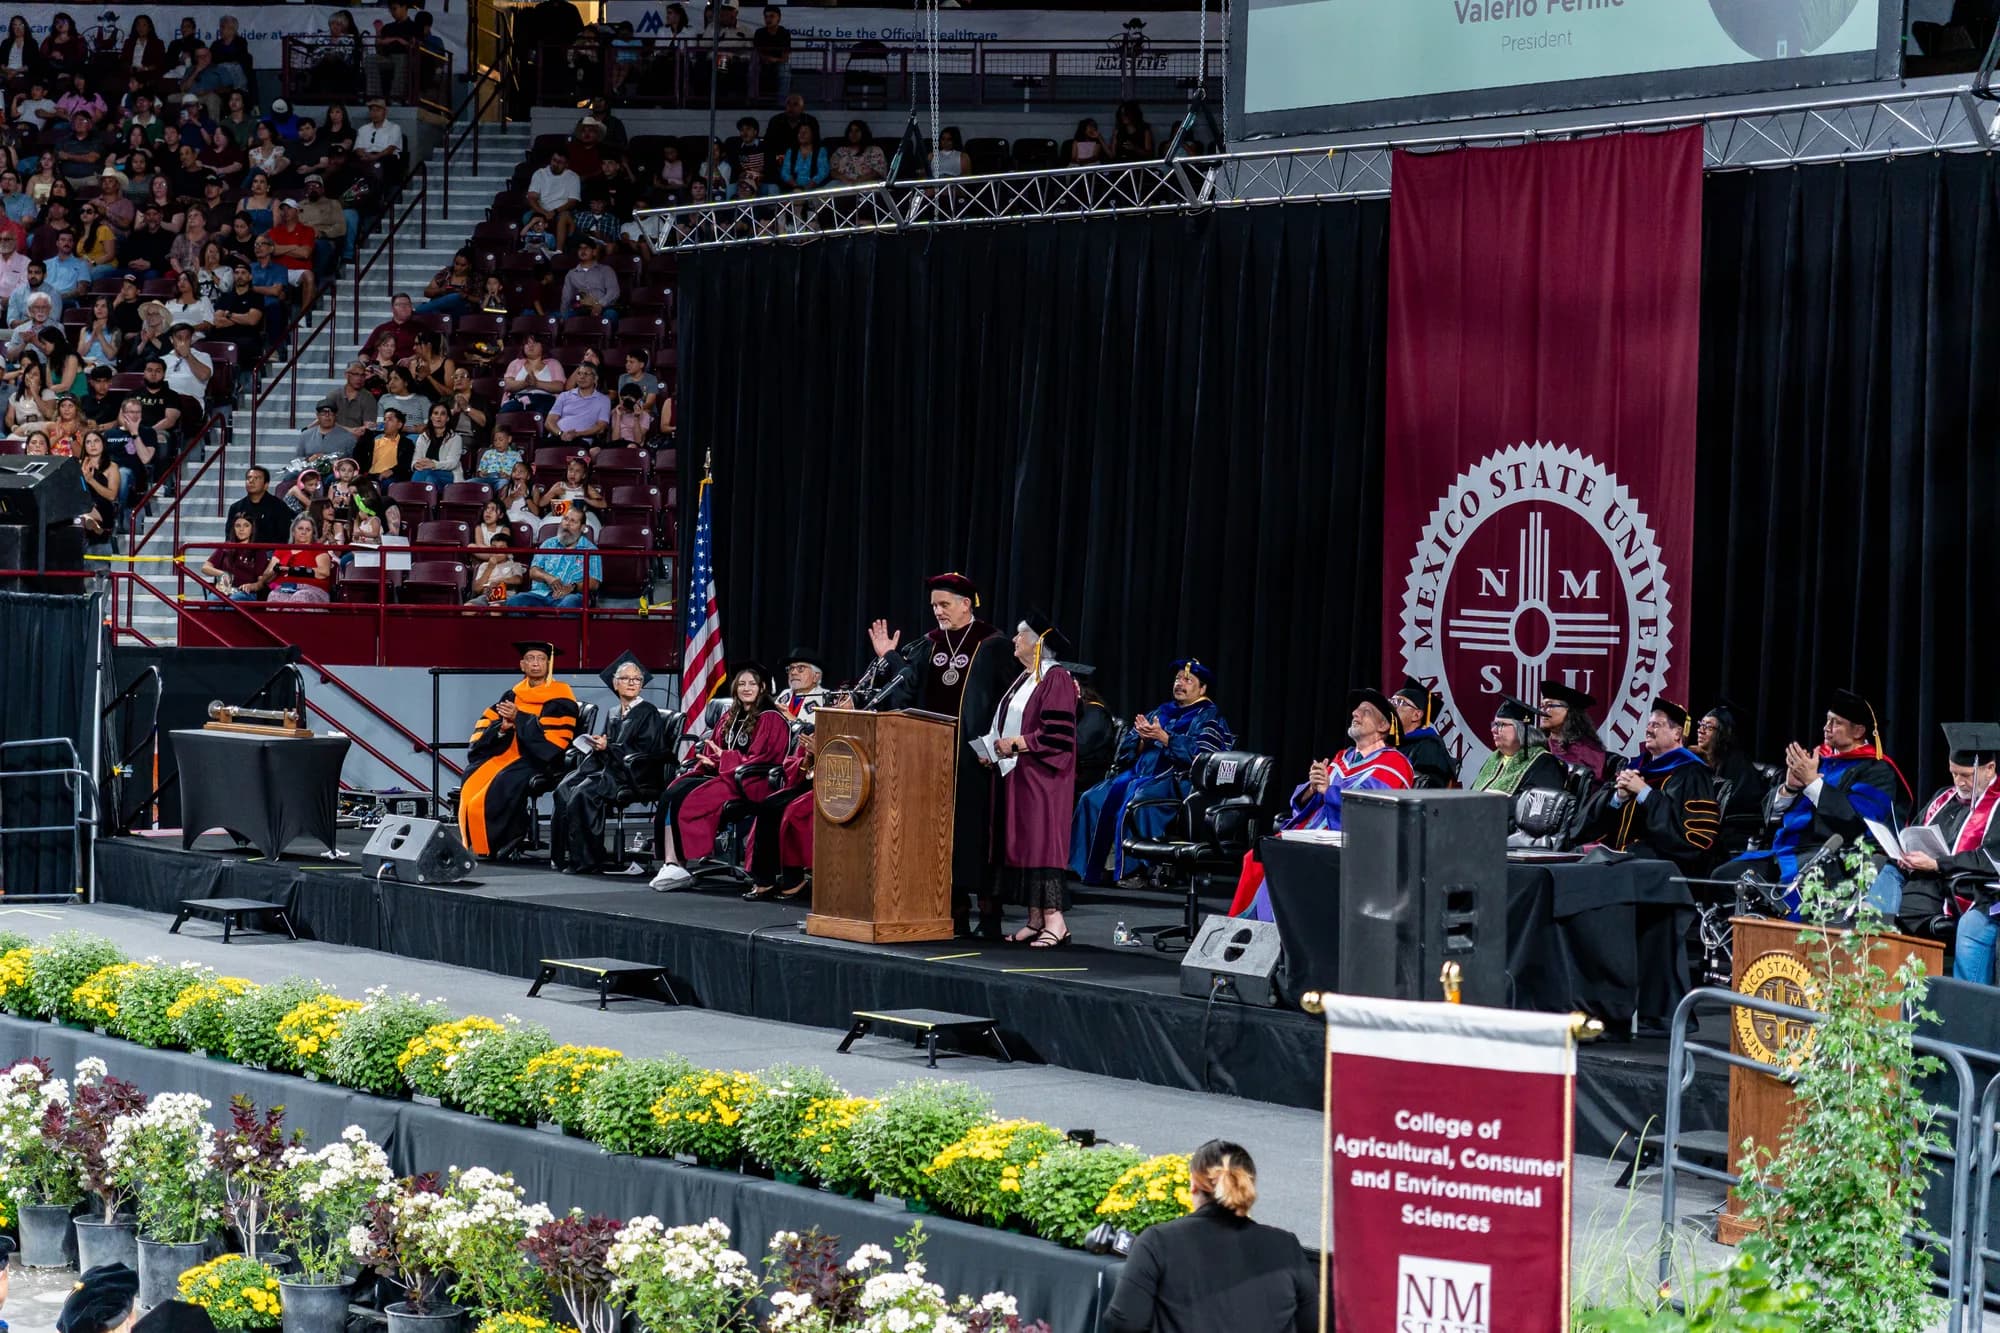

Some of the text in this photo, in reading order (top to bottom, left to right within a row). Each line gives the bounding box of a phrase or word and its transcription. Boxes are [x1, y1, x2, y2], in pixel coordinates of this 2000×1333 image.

[1454, 0, 1538, 24] Valerio
[175, 29, 201, 40] Fd
[271, 30, 283, 40] at
[785, 26, 999, 41] roud to be the Official Healthcare
[1502, 30, 1573, 51] President
[1096, 56, 1167, 70] NM STATE
[1477, 568, 1600, 599] N M
[1414, 489, 1481, 651] MEXICO
[1489, 460, 1597, 507] STATE
[1603, 498, 1658, 752] UNIVERSIT
[1480, 665, 1594, 695] S U
[828, 759, 851, 778] NM
[1742, 961, 1802, 1057] NEW MXICO STATE
[1763, 989, 1801, 1006] N M
[1764, 1024, 1801, 1041] S U
[1394, 1109, 1502, 1140] College of
[1333, 1133, 1565, 1177] Agricultural, Consumer
[1351, 1169, 1542, 1208] and Environmental
[1401, 1203, 1491, 1234] Sciences
[1402, 1273, 1486, 1326] NM
